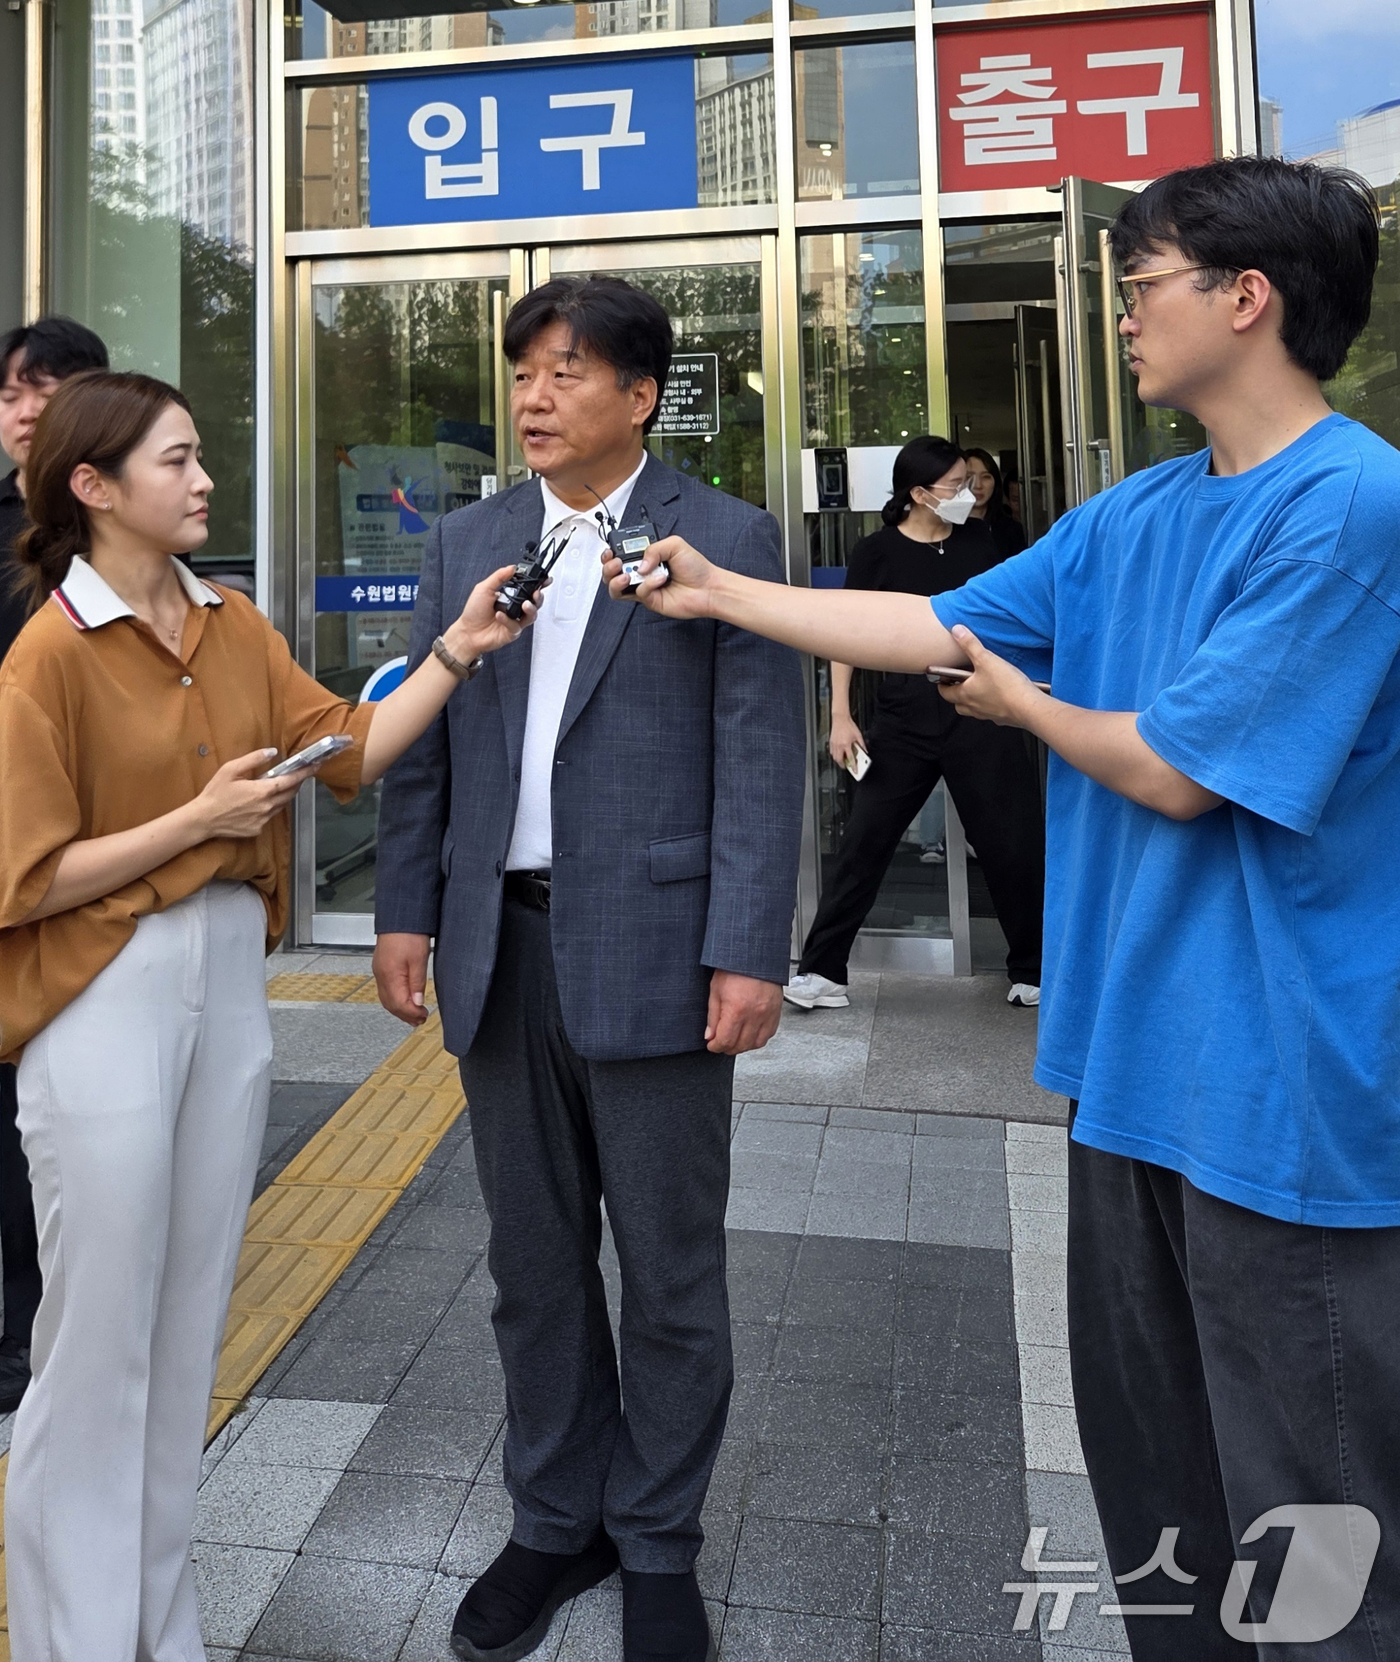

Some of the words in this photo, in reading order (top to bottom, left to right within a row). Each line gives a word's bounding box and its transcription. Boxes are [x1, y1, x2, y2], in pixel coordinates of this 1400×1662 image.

[407, 88, 646, 200] 입구
[948, 46, 1200, 166] 출구
[690, 363, 704, 372] 안내
